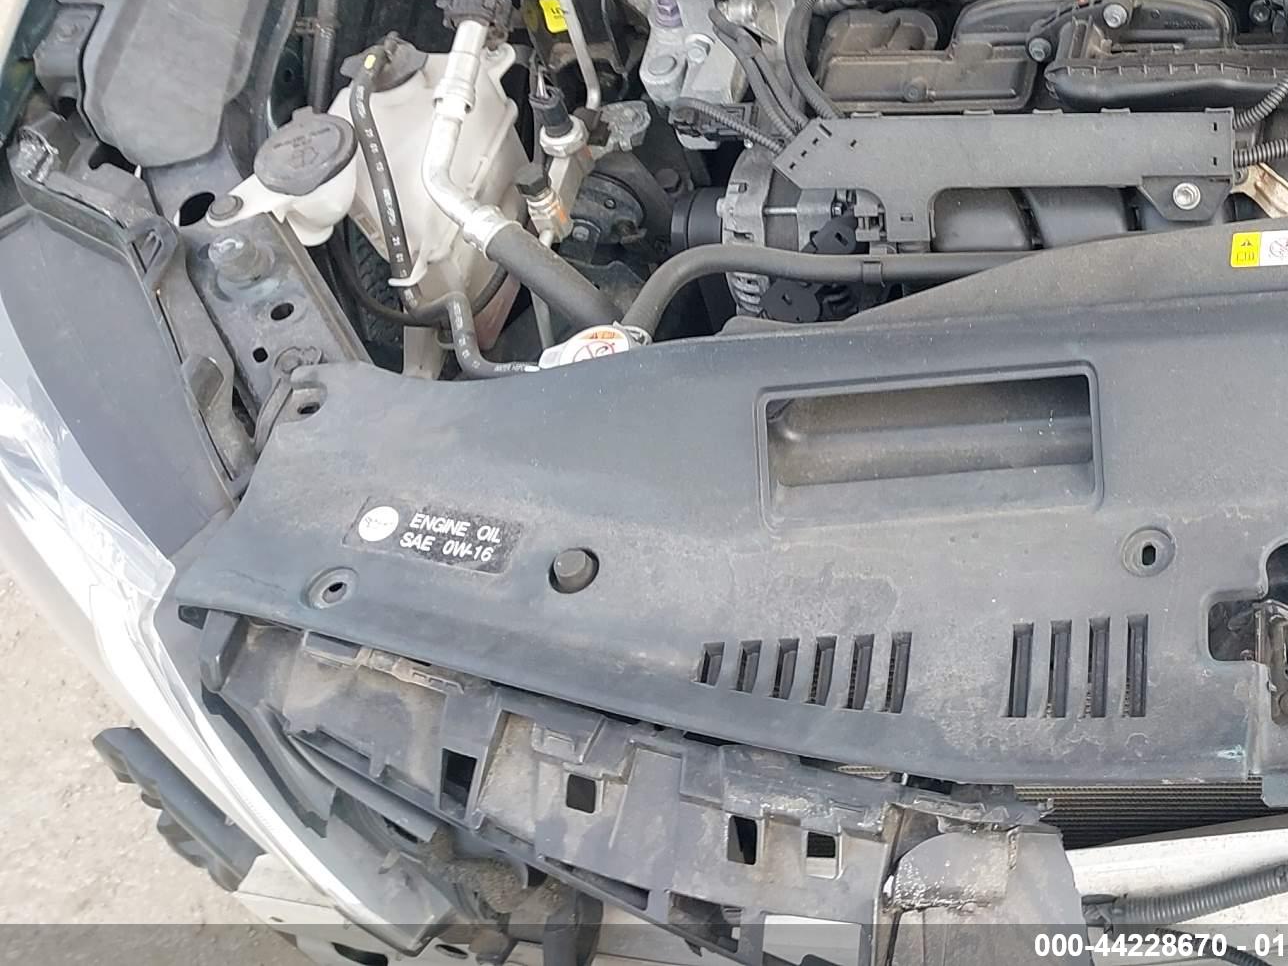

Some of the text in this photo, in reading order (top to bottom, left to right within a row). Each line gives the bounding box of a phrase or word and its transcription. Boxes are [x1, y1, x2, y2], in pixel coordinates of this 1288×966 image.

[409, 512, 471, 537] ENGINE
[476, 525, 501, 544] OIL
[399, 531, 494, 562] SAE 0W-16
